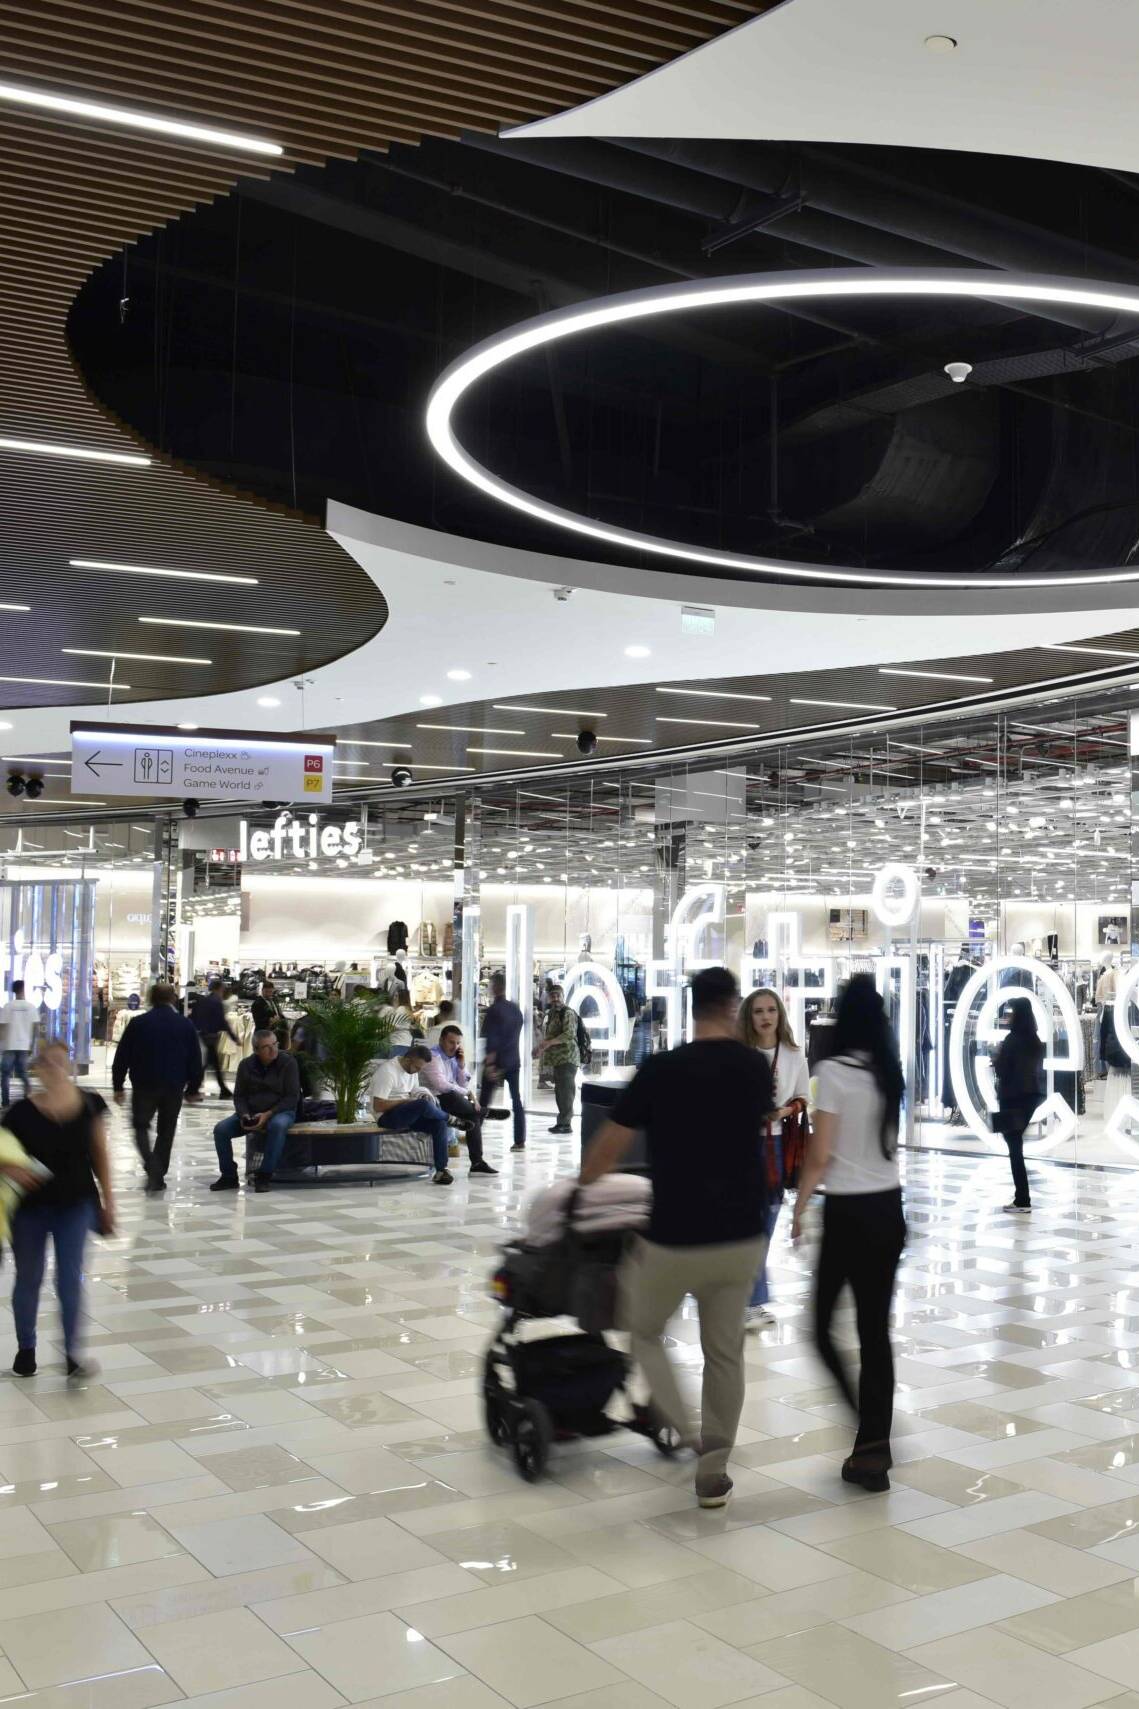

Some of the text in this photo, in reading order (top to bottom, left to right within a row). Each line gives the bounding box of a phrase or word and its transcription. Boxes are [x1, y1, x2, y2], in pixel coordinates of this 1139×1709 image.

[184, 748, 238, 760] Cineplexx
[184, 763, 255, 776] Food Avenue
[306, 760, 321, 769] P6
[183, 778, 251, 790] Game World
[306, 779, 320, 788] P7
[239, 812, 362, 862] lefties
